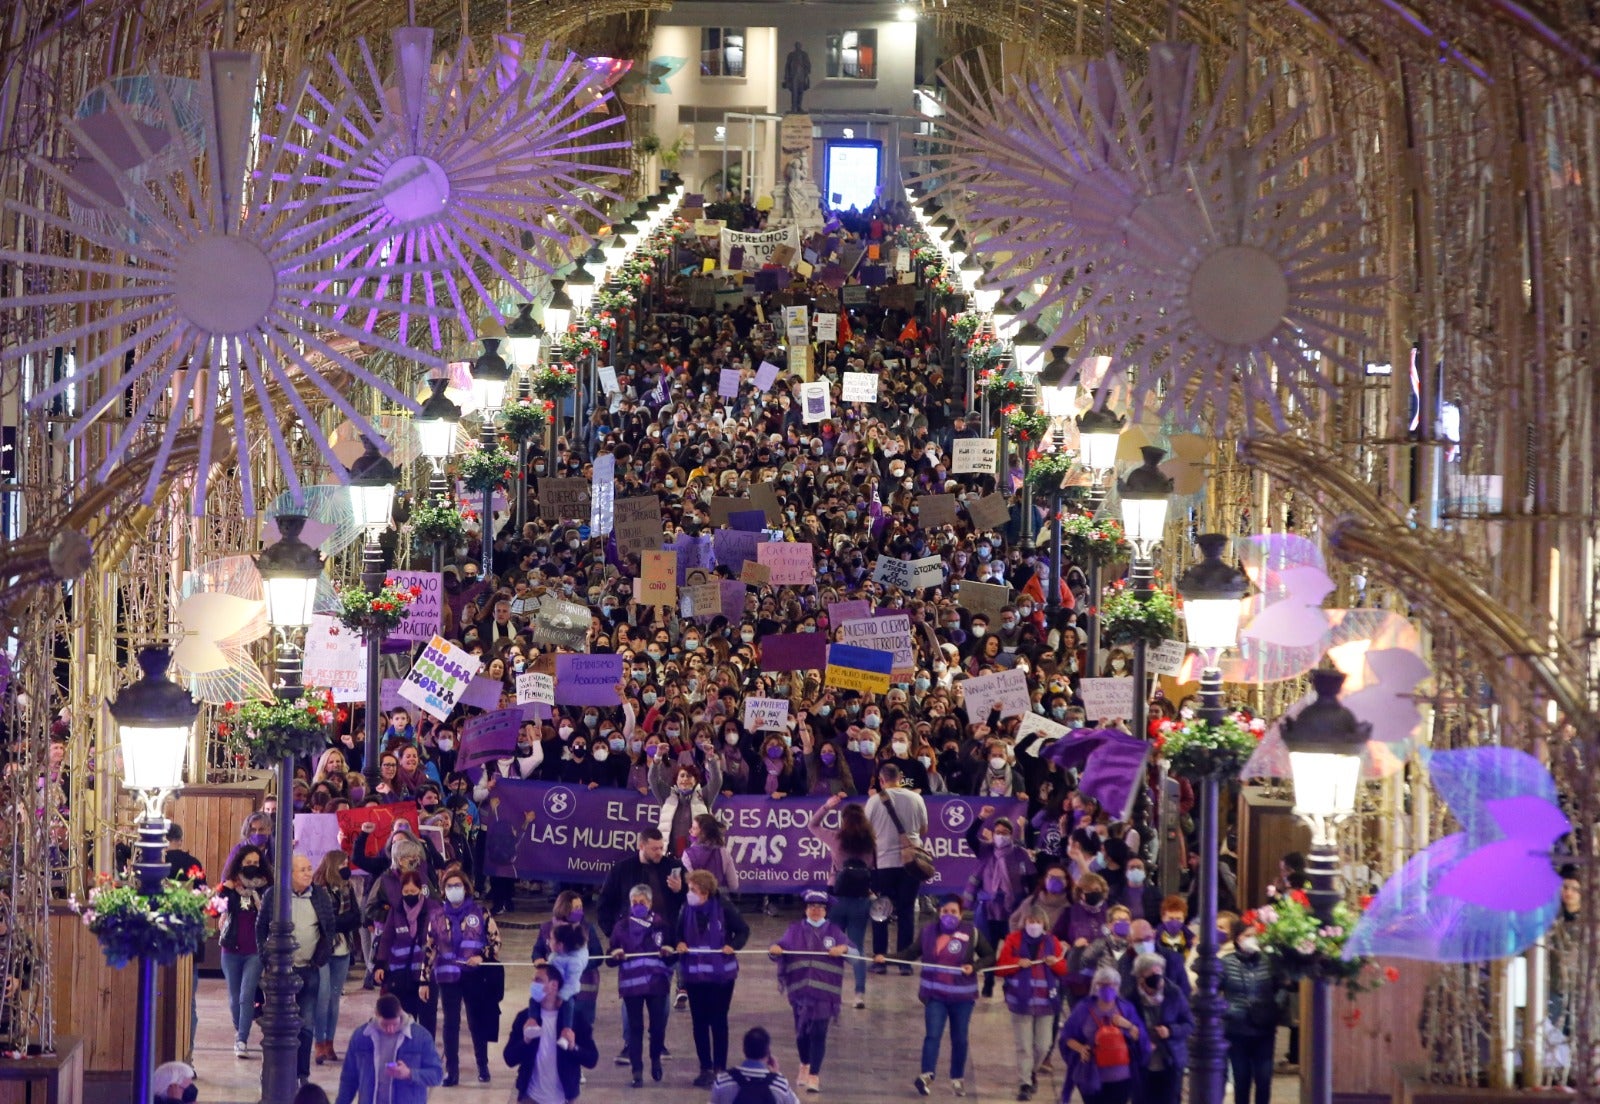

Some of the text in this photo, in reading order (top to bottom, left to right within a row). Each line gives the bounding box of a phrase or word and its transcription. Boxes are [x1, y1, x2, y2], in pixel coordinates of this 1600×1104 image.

[731, 231, 789, 243] DERECHOS
[396, 576, 438, 591] PORNO
[649, 581, 667, 590] COÑO
[880, 574, 909, 587] ACOSO
[396, 620, 438, 637] PRÁCTICA
[844, 619, 909, 637] NUESTRO CUERPO
[431, 636, 451, 655] NO
[424, 646, 470, 684] MUJER
[572, 658, 615, 671] FEMINISMO
[1151, 653, 1181, 665] PUTERO
[317, 669, 358, 680] RESPETO
[416, 658, 457, 690] PARA
[408, 669, 454, 705] MORIR
[606, 801, 630, 822] EL
[739, 809, 761, 828] ES
[531, 824, 568, 846] LAS
[573, 826, 640, 852] MUJER
[568, 857, 615, 872] Movimi
[734, 868, 789, 881] sociativo
[793, 868, 810, 881] de
